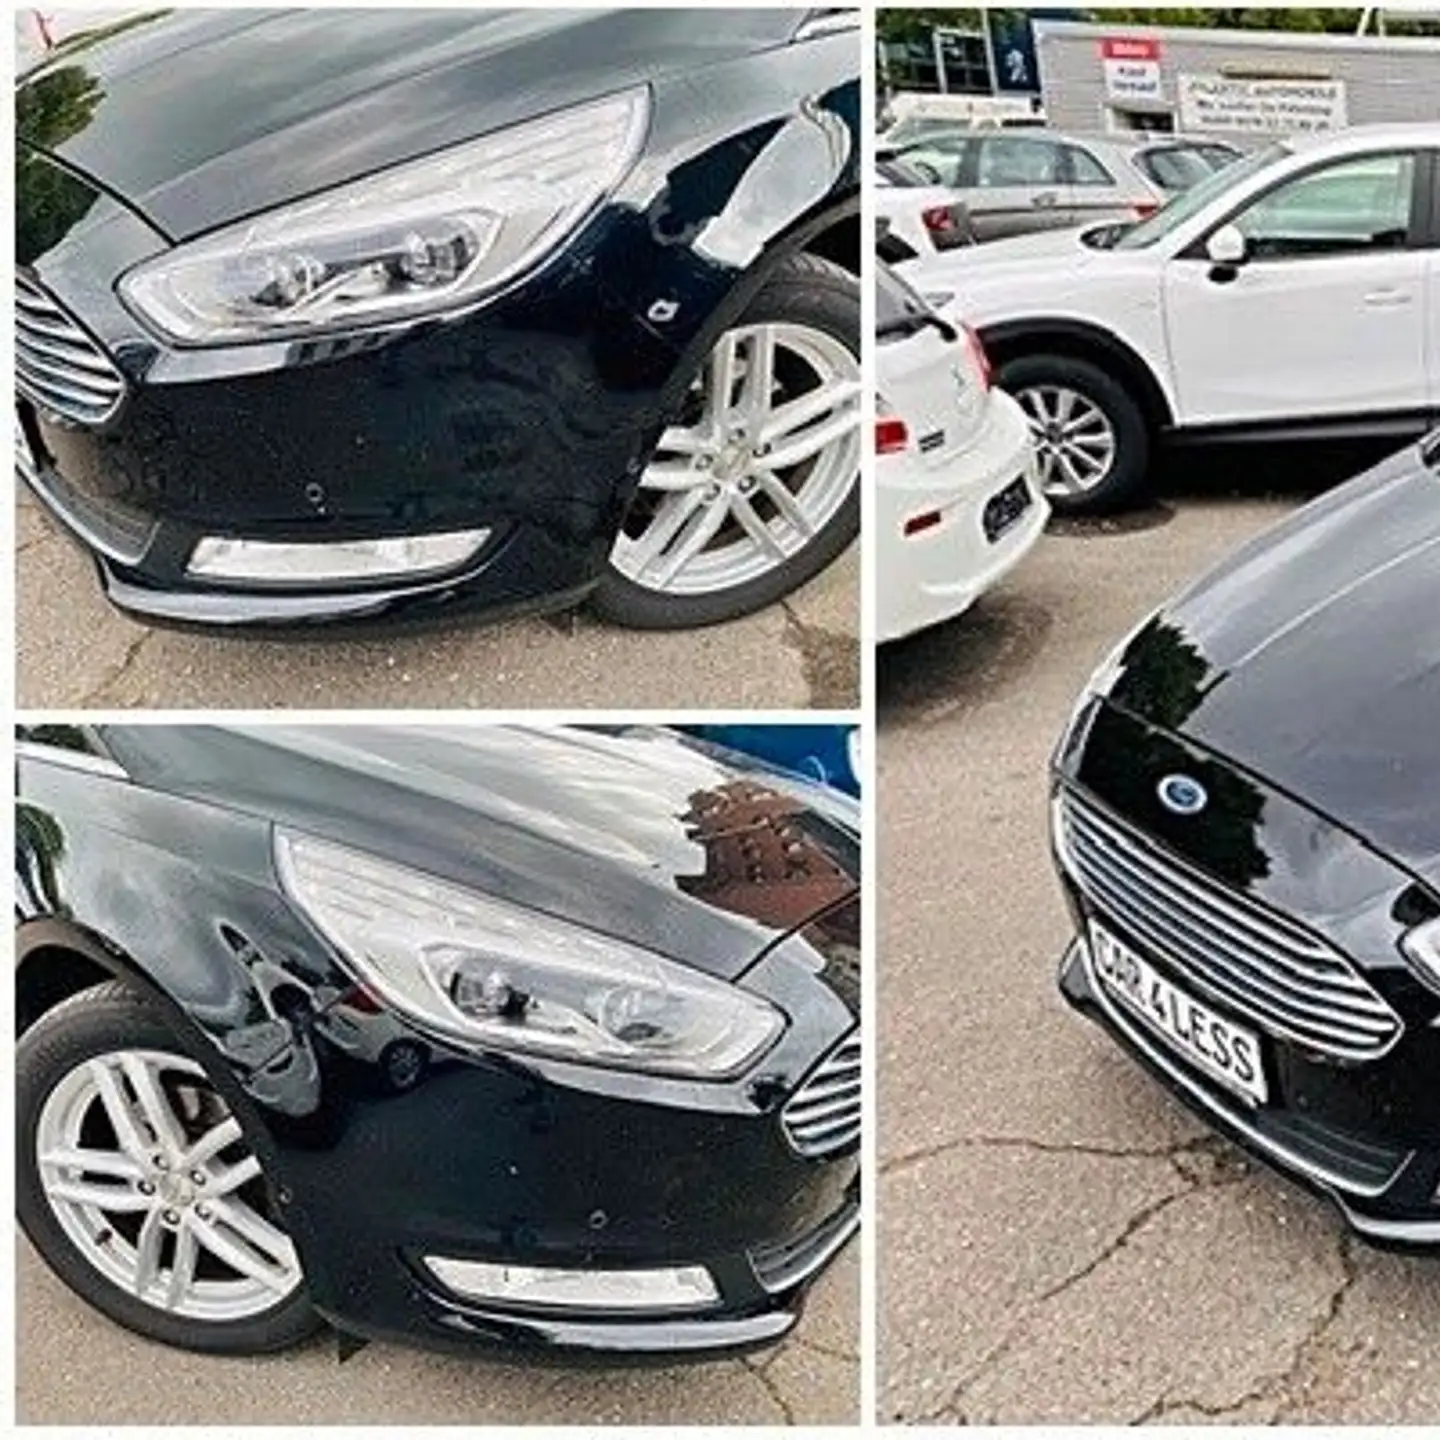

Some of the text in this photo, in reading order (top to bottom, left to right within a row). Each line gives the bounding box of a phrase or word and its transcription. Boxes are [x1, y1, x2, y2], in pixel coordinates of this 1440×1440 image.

[1095, 930, 1255, 1082] CAR 4 LESS
